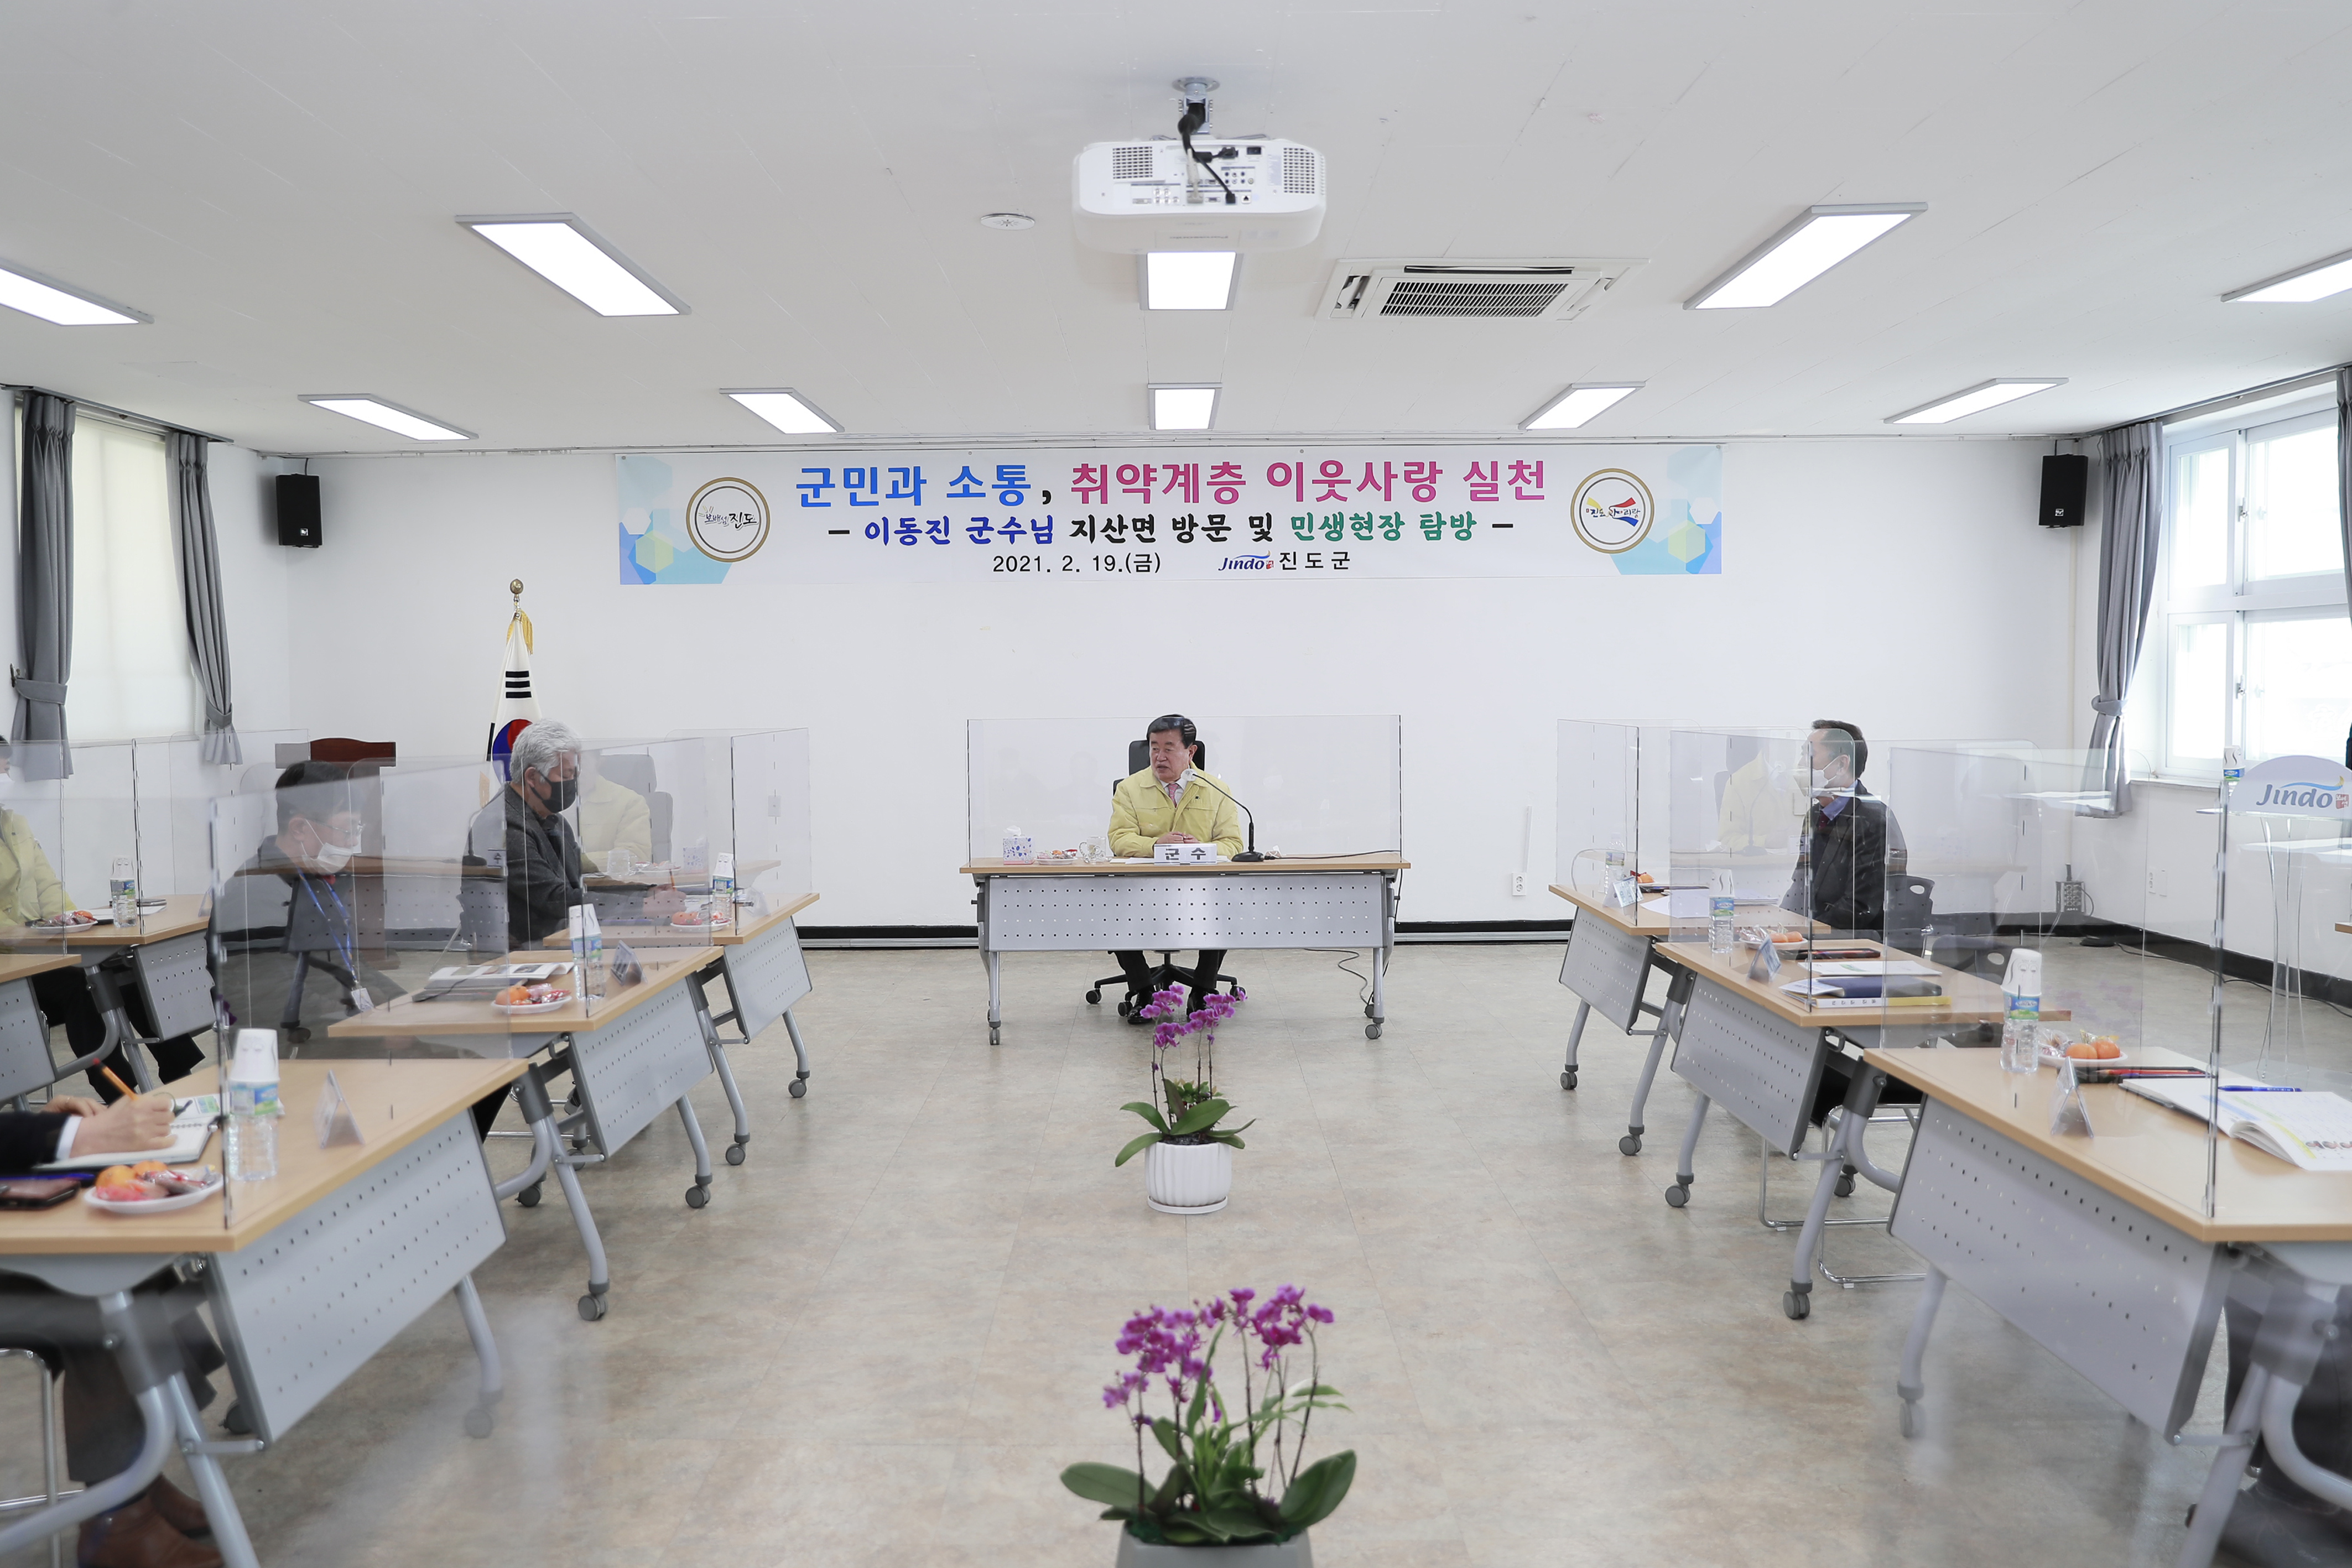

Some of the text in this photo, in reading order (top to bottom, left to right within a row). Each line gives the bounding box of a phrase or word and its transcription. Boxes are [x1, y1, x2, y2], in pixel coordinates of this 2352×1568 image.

[797, 460, 1544, 507] 군민과 소통, 취약계층 이웃사랑 실천
[729, 512, 758, 529] 진도
[865, 515, 950, 546] 이동진
[966, 515, 1053, 545] 군수님
[1069, 514, 1156, 544] 지산면
[1172, 513, 1232, 543] 방문
[1248, 512, 1272, 542] 및
[1291, 512, 1405, 541] 민생현장
[1420, 512, 1477, 541] 탐방
[993, 553, 1161, 574] 2021. 2. 19.(금)
[1218, 558, 1265, 571] Jindo
[2256, 784, 2333, 809] Jindo
